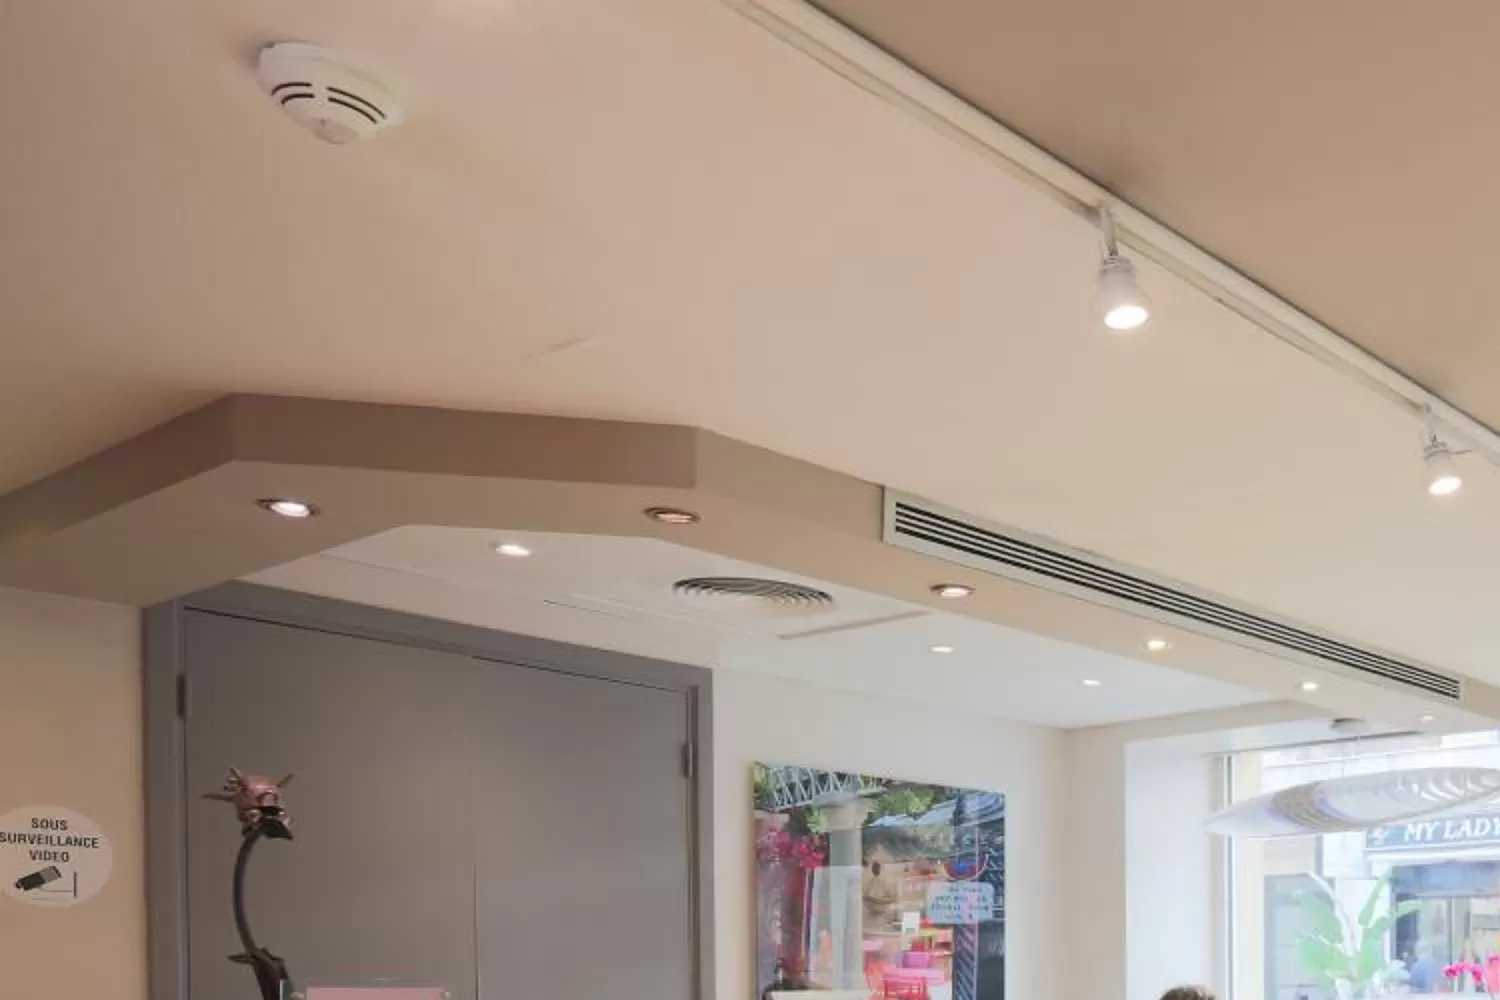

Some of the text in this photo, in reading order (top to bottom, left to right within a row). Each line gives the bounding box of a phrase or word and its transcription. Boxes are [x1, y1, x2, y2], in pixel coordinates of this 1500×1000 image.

[31, 817, 69, 831] SOUS
[1404, 821, 1440, 842] MY
[0, 832, 100, 849] SURVEILLANCE
[29, 849, 70, 863] VIDEO
